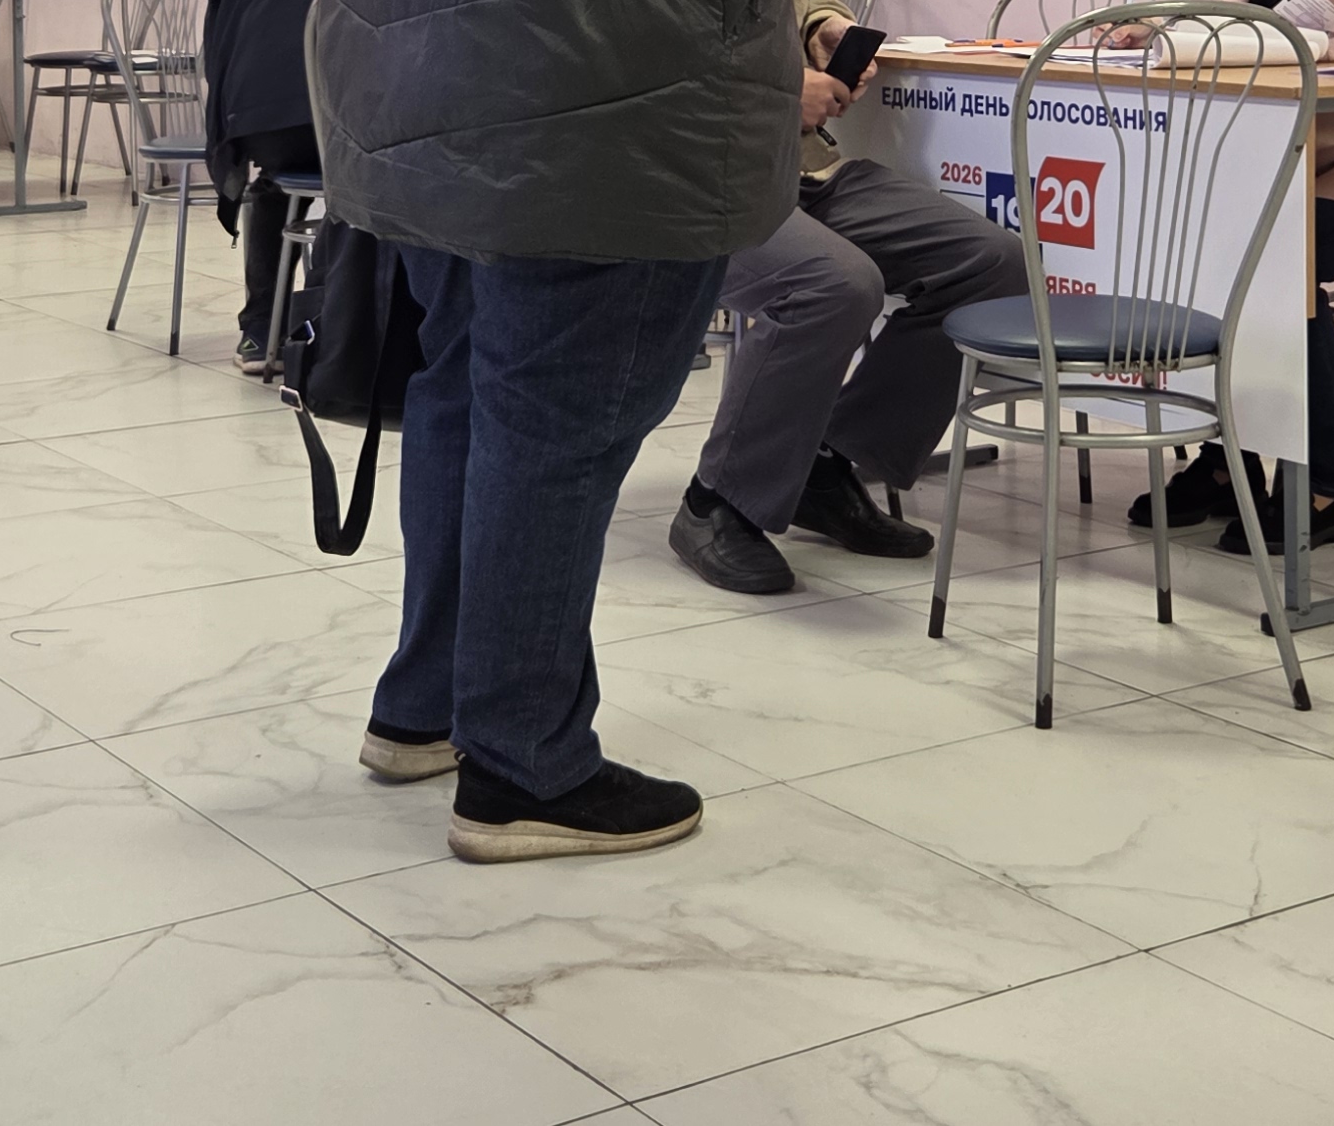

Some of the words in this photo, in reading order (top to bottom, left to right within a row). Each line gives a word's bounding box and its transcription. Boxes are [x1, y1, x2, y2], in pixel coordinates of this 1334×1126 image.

[881, 86, 956, 112] ЕДИНЫЙ
[960, 93, 1010, 117] ДЕНЬ
[1027, 99, 1167, 133] ОЛОСОВАНИЯ
[940, 161, 982, 186] 2026
[1040, 176, 1091, 228] 20
[1045, 275, 1096, 294] ЯБРЯ
